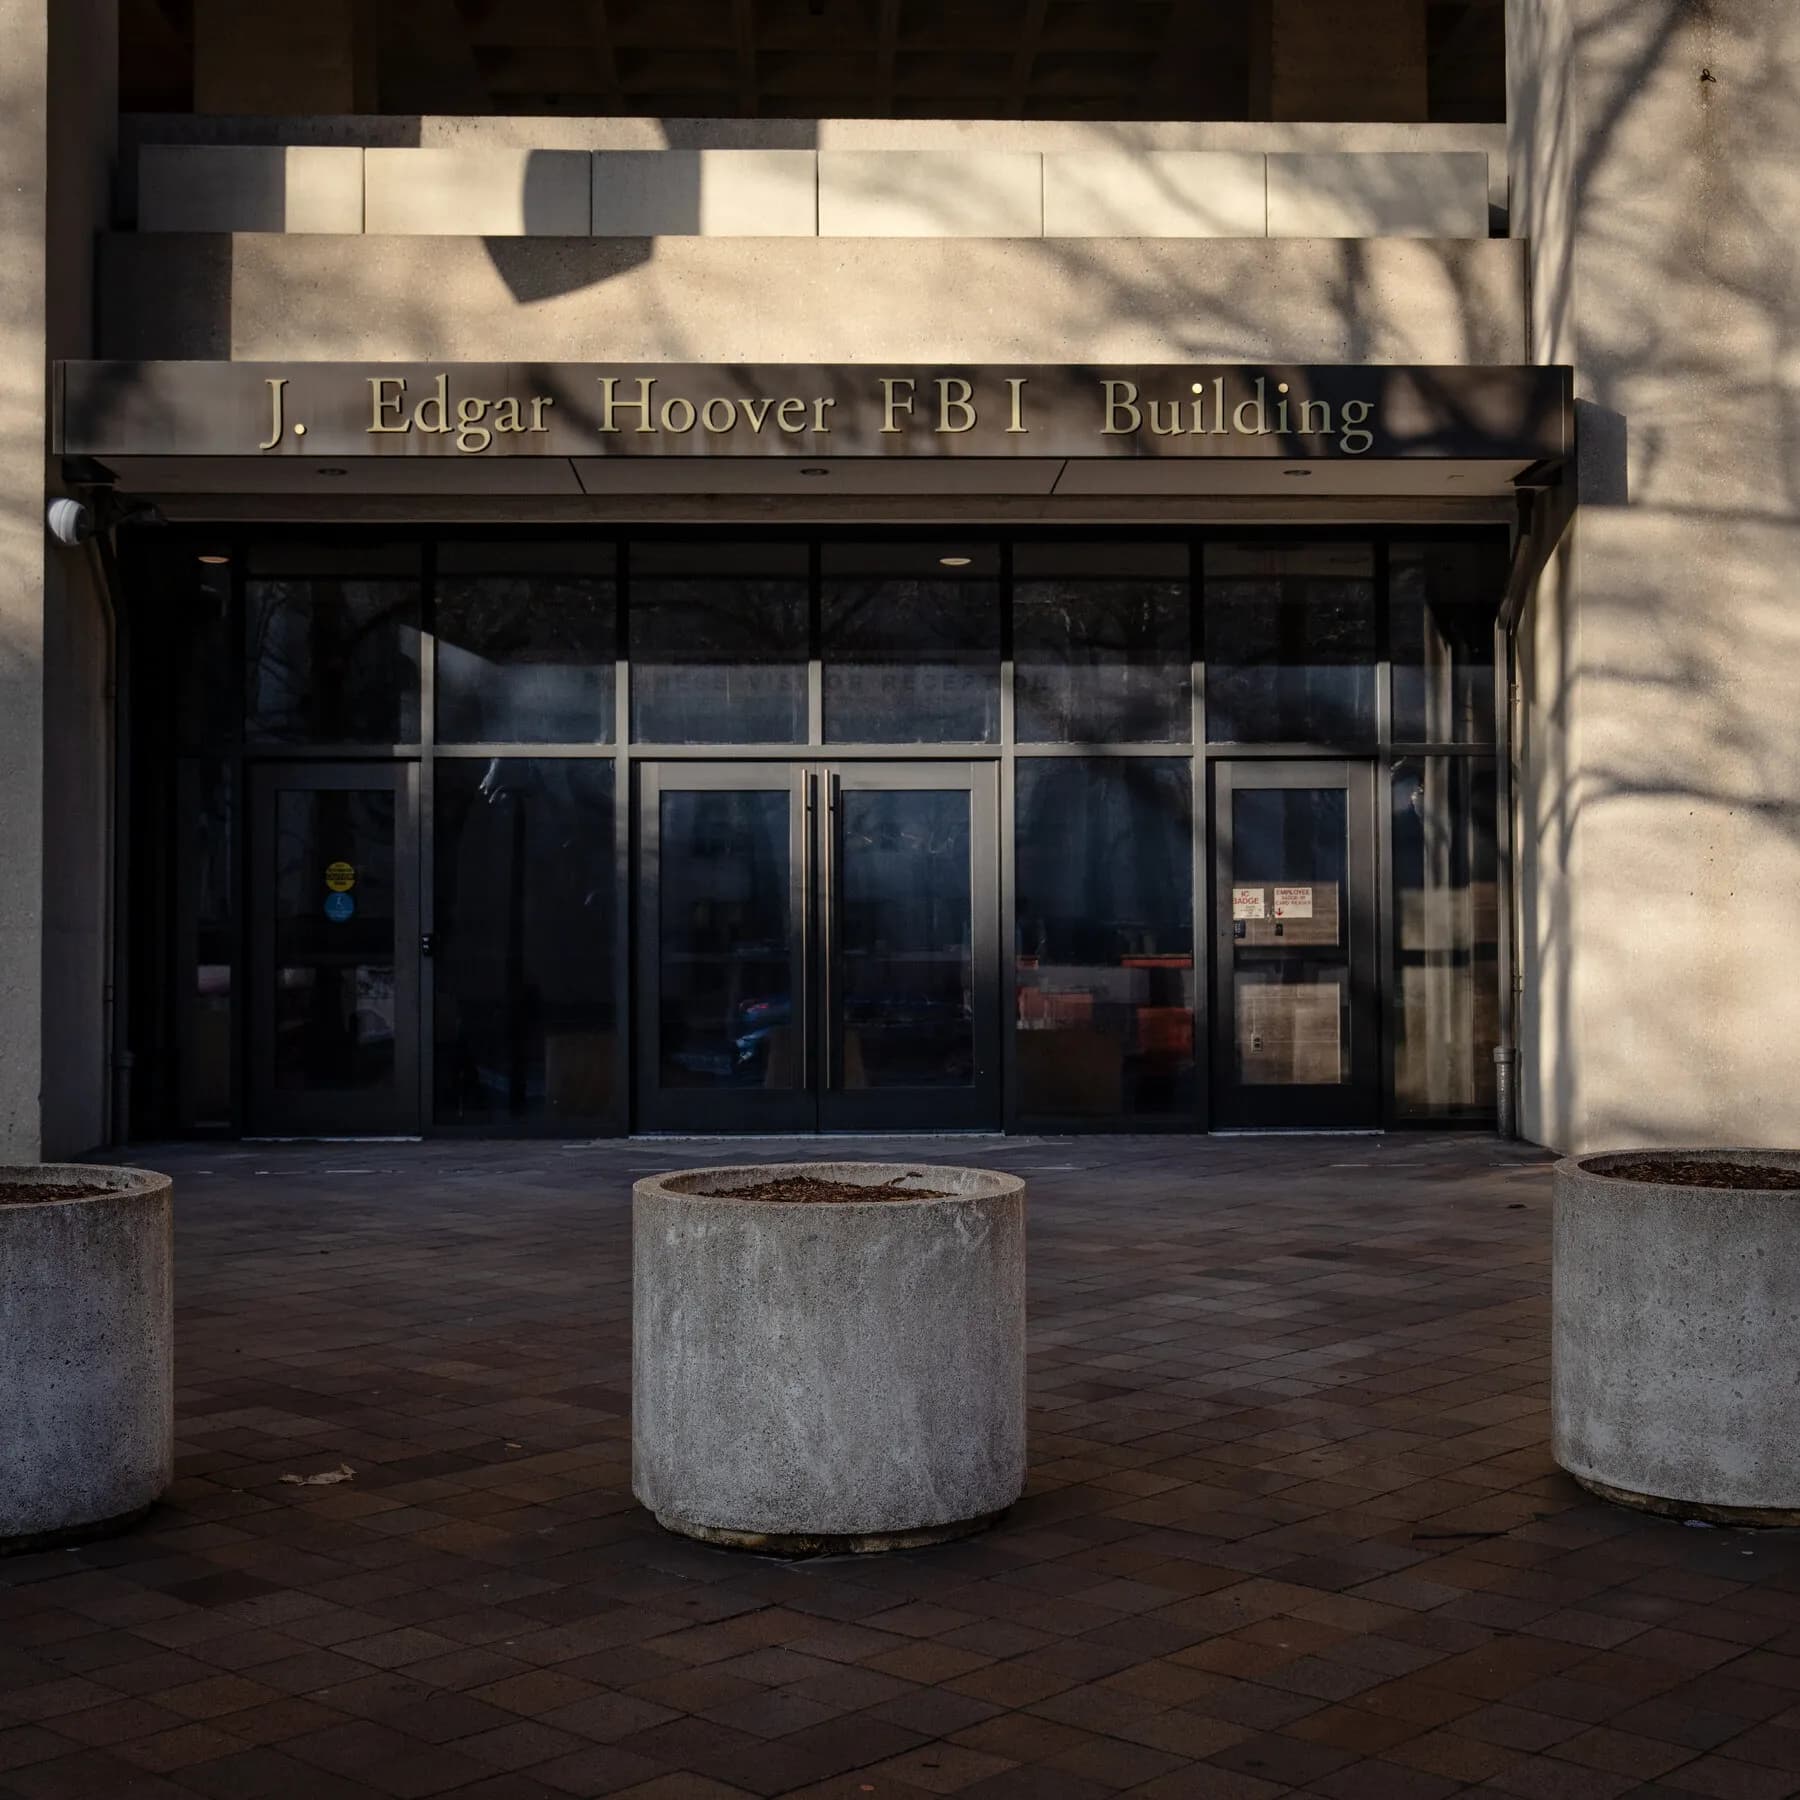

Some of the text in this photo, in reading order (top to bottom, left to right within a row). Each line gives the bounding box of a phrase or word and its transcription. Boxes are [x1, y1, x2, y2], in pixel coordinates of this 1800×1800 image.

[259, 378, 307, 449] J.
[366, 373, 553, 453] Edgar
[597, 377, 836, 434] Hoover
[1100, 377, 1375, 454] Building
[880, 673, 1049, 693] RECEPTON
